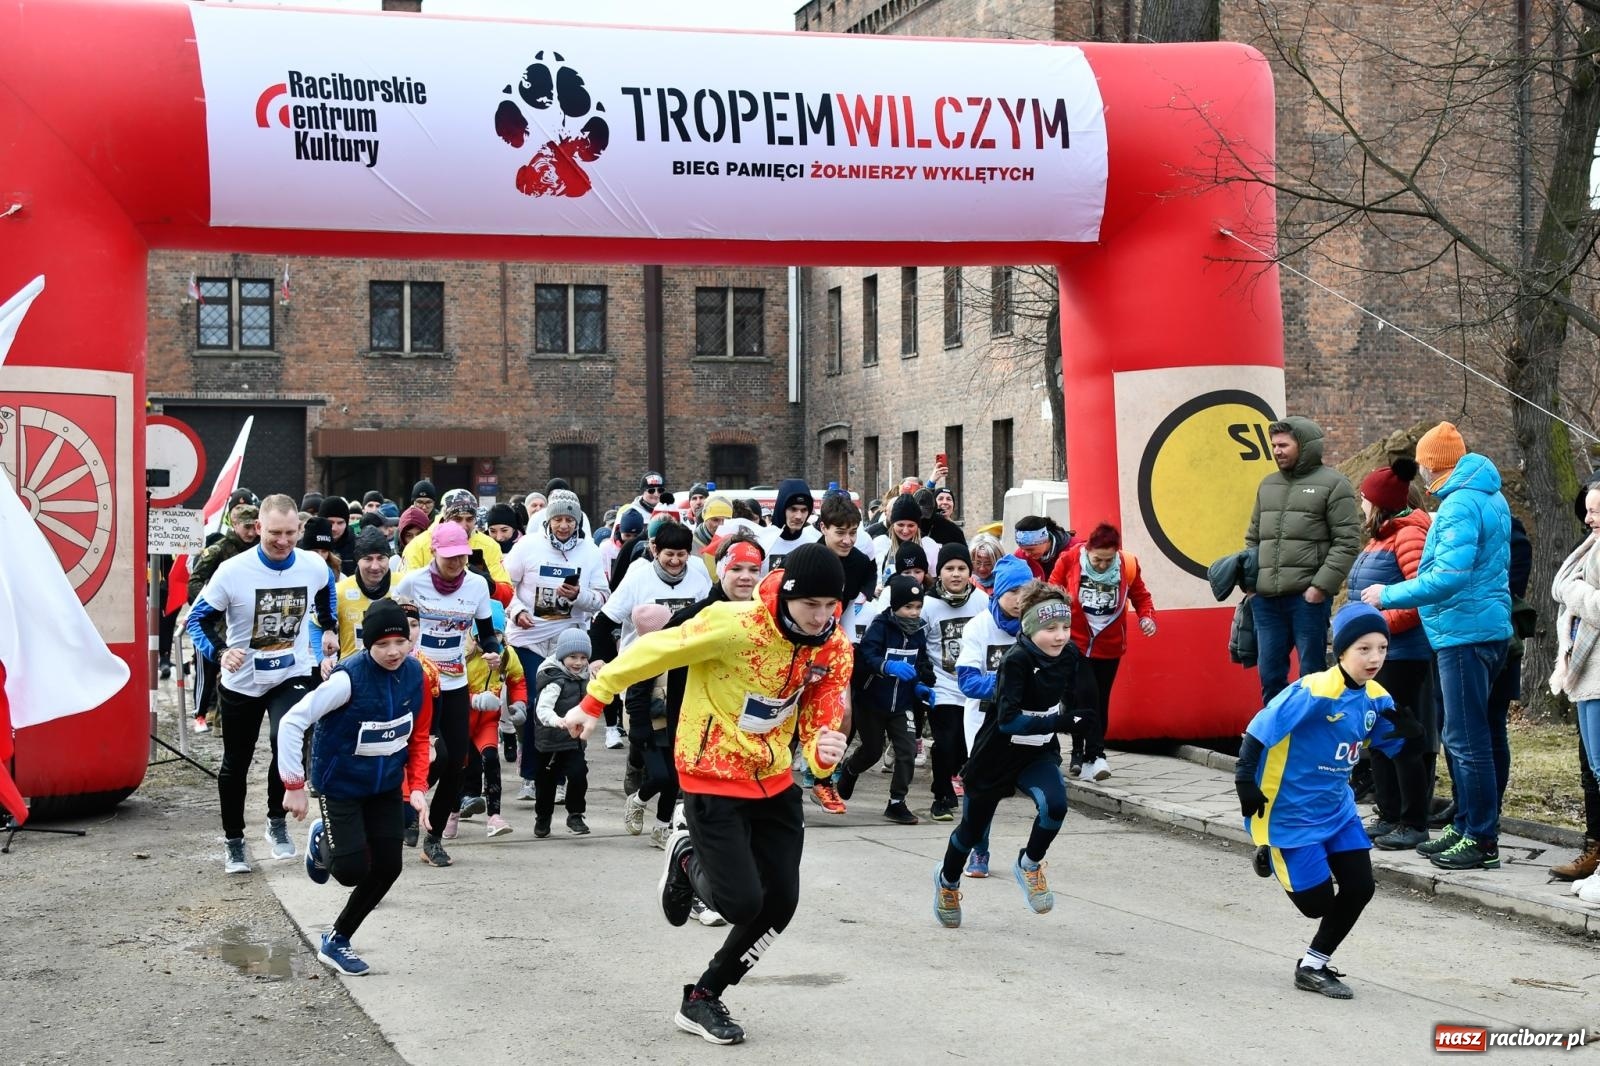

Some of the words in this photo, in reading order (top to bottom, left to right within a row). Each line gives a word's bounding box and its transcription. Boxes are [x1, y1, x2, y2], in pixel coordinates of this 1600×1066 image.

[287, 70, 428, 105] Raciborskie
[294, 130, 380, 168] Kultury
[672, 160, 720, 176] BIEG
[726, 161, 805, 182] PAMIĘCI
[810, 159, 917, 181] ŻOŁNIERZY
[922, 165, 1035, 185] WYKLĘTYCH
[552, 568, 563, 576] 20
[783, 579, 796, 591] 4F
[438, 639, 447, 647] 17
[269, 659, 281, 668] 39
[381, 730, 396, 739] 40
